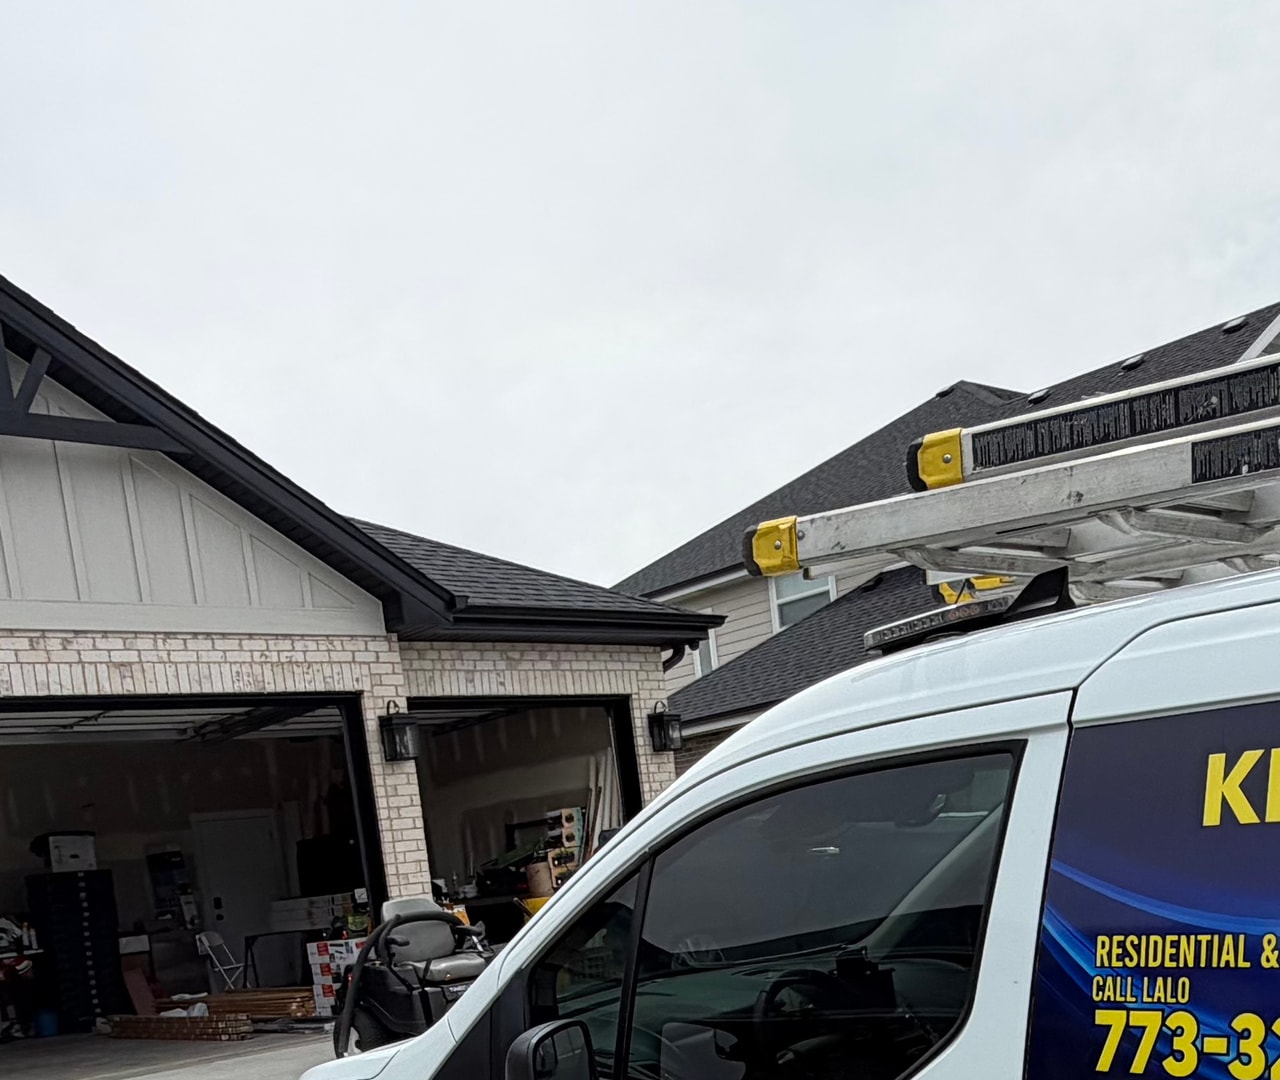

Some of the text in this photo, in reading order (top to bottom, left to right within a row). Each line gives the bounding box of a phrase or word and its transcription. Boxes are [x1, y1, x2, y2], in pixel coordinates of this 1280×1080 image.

[1095, 935, 1251, 968] RESIDENTIAL
[1261, 934, 1280, 969] &
[1091, 976, 1190, 1004] CALL LALO
